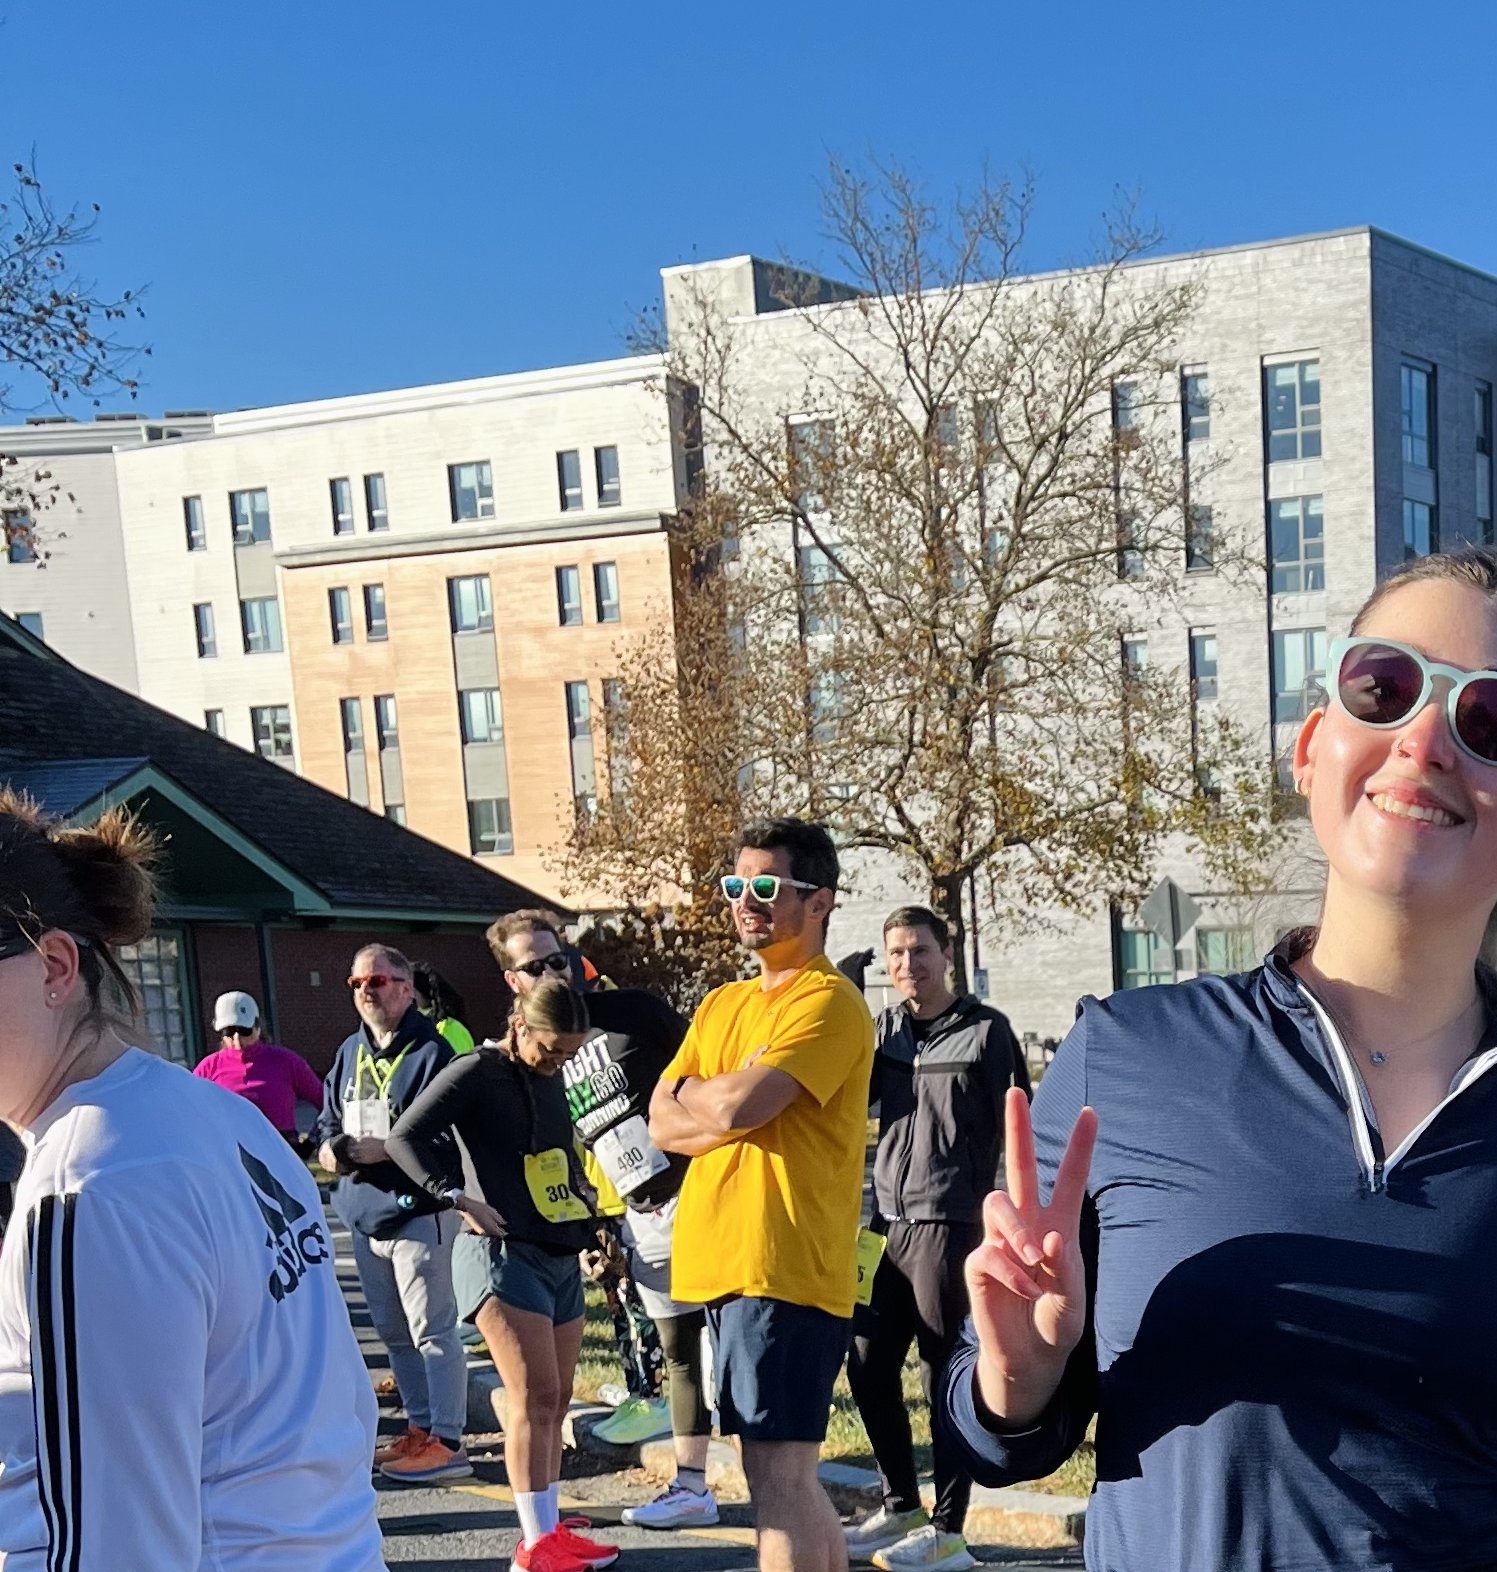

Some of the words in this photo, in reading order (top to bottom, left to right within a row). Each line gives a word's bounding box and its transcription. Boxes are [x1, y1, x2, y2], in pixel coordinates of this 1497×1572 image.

[562, 1033, 611, 1089] IGHT
[590, 1062, 629, 1102] GO
[616, 1146, 644, 1172] 480
[545, 1183, 570, 1203] 30
